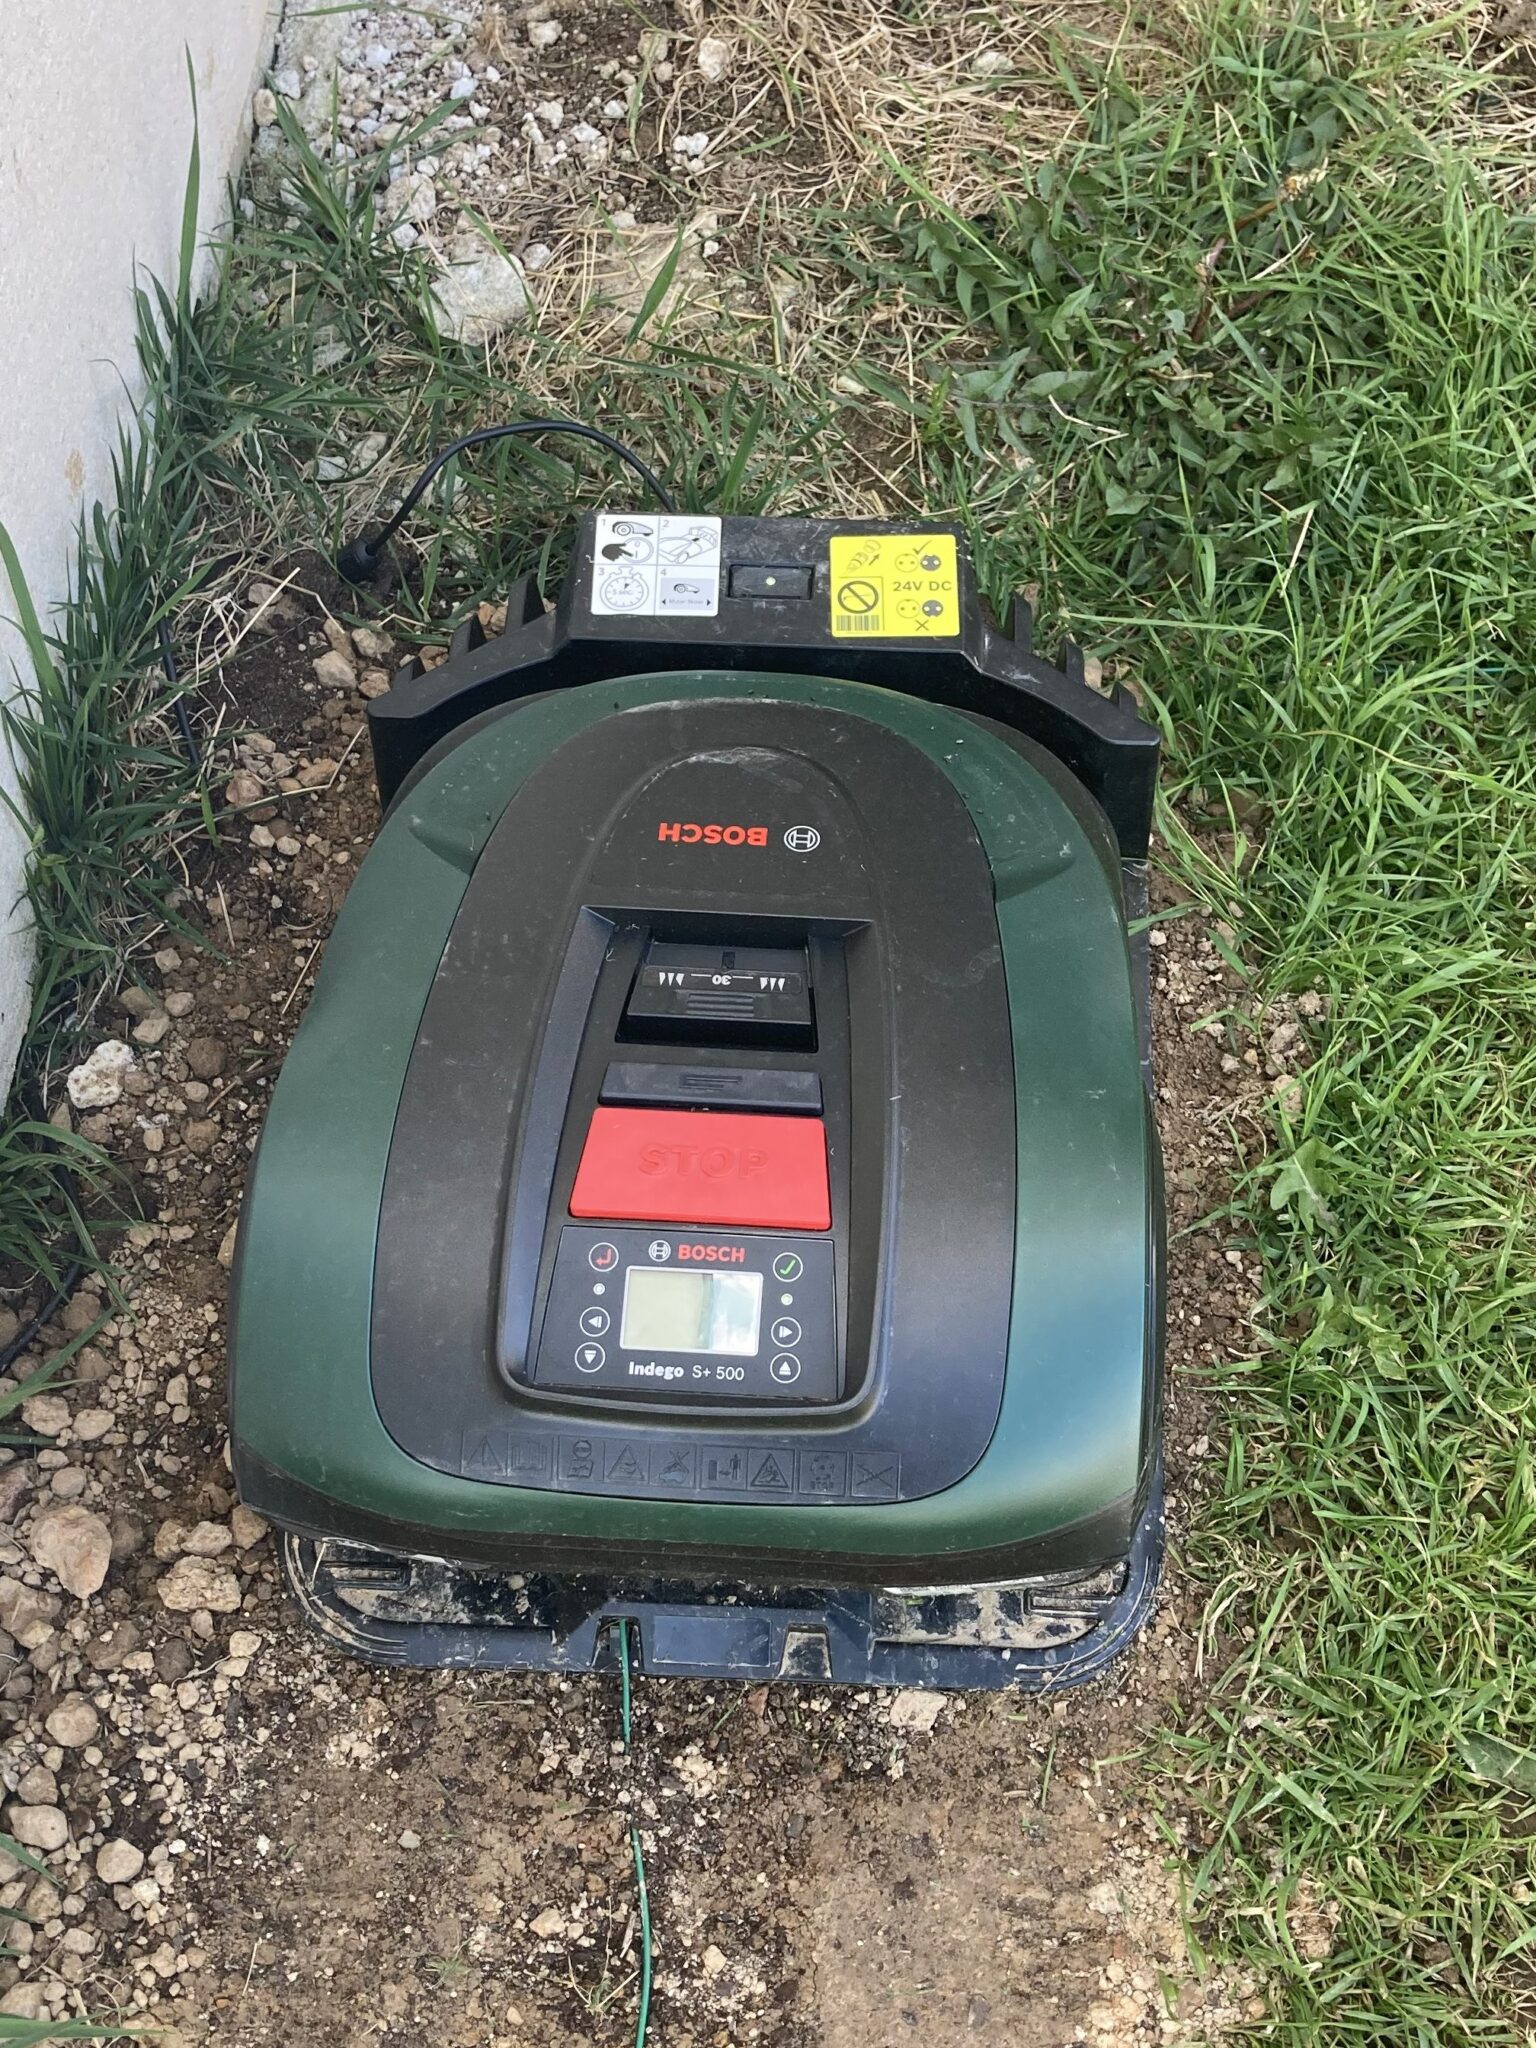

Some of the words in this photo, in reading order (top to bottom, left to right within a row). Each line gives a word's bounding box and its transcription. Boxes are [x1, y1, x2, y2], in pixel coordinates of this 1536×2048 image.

[663, 520, 670, 528] 2
[598, 567, 605, 576] 3
[660, 568, 667, 576] 4
[892, 580, 923, 592] 24V
[929, 580, 952, 592] DC
[657, 822, 769, 847] BOSCH
[711, 974, 732, 986] 30
[638, 1142, 769, 1181] STOP
[677, 1244, 746, 1263] BOSCH
[628, 1360, 685, 1379] Indego
[692, 1364, 712, 1378] S+
[716, 1366, 745, 1381] 500
